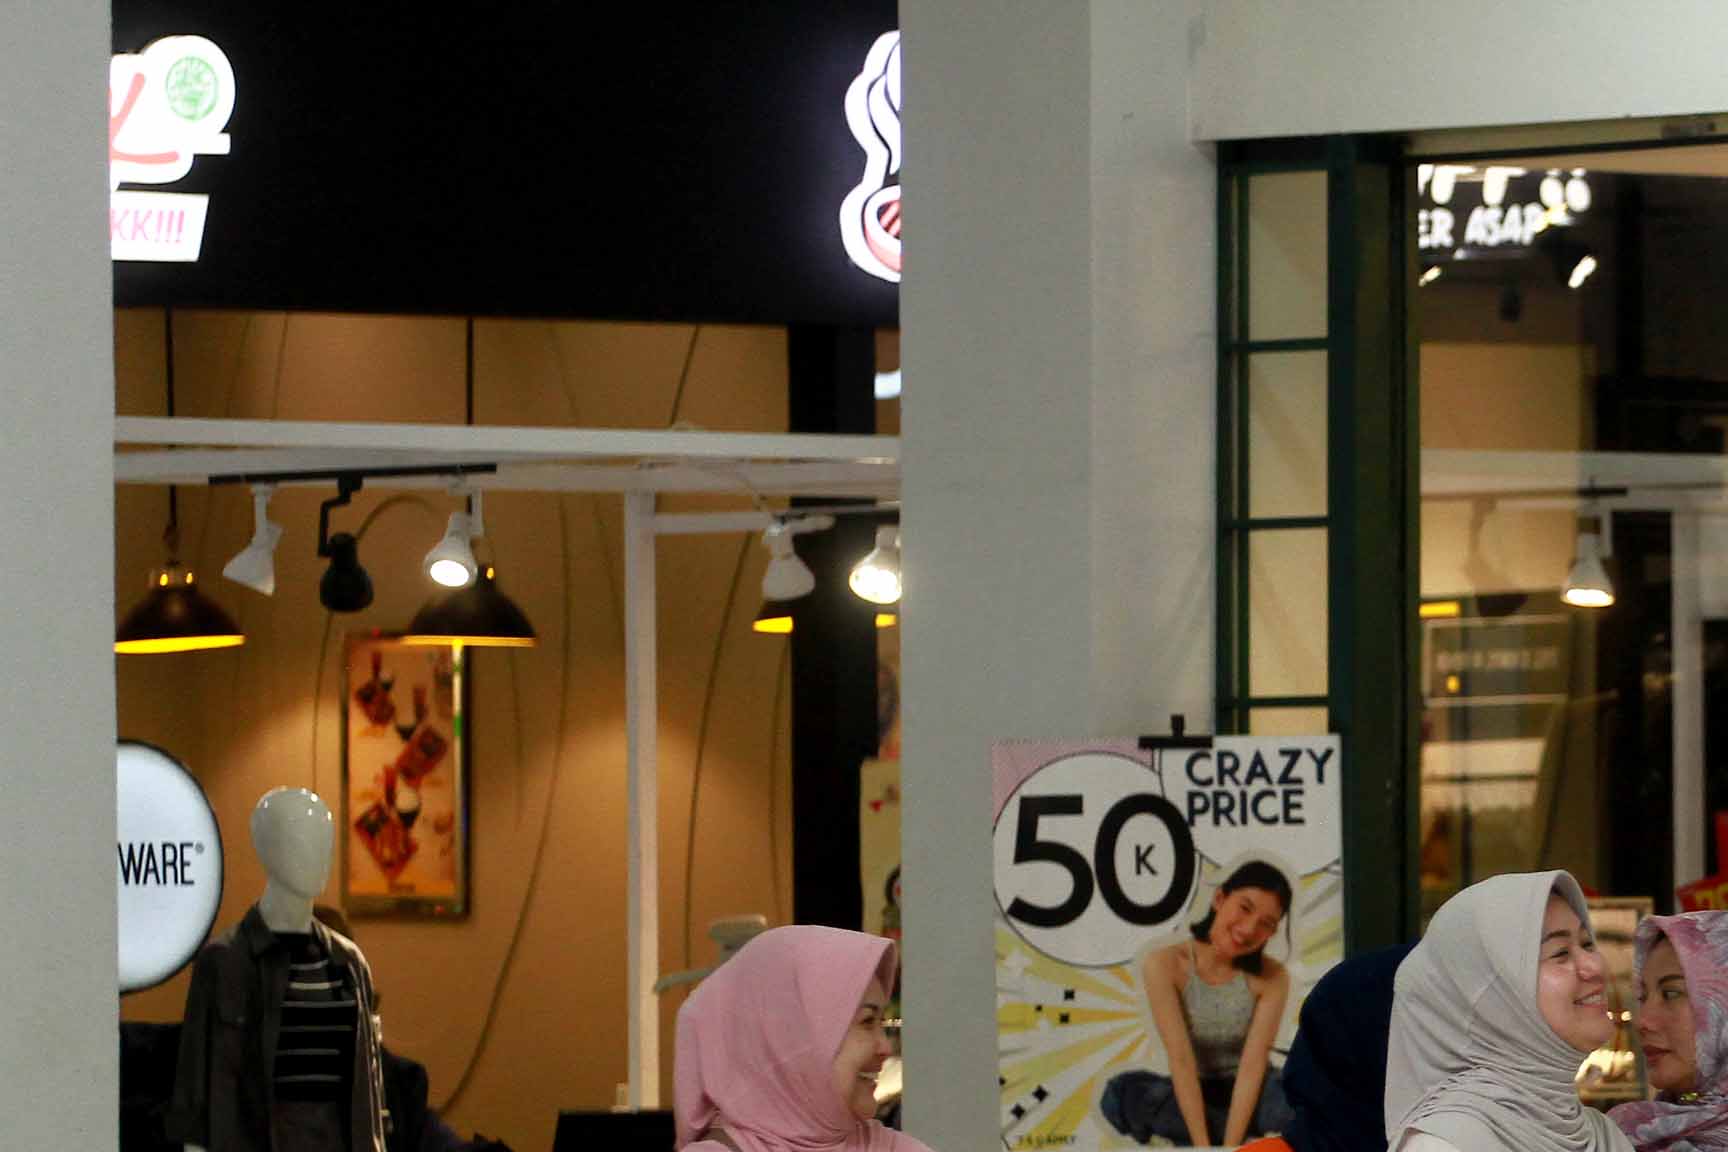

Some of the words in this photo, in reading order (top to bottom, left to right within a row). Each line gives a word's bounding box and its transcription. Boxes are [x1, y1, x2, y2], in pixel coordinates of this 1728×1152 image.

[1185, 747, 1335, 787] CRAZY
[1186, 788, 1306, 828] PRICE
[1007, 793, 1195, 929] 50
[1134, 845, 1159, 877] K
